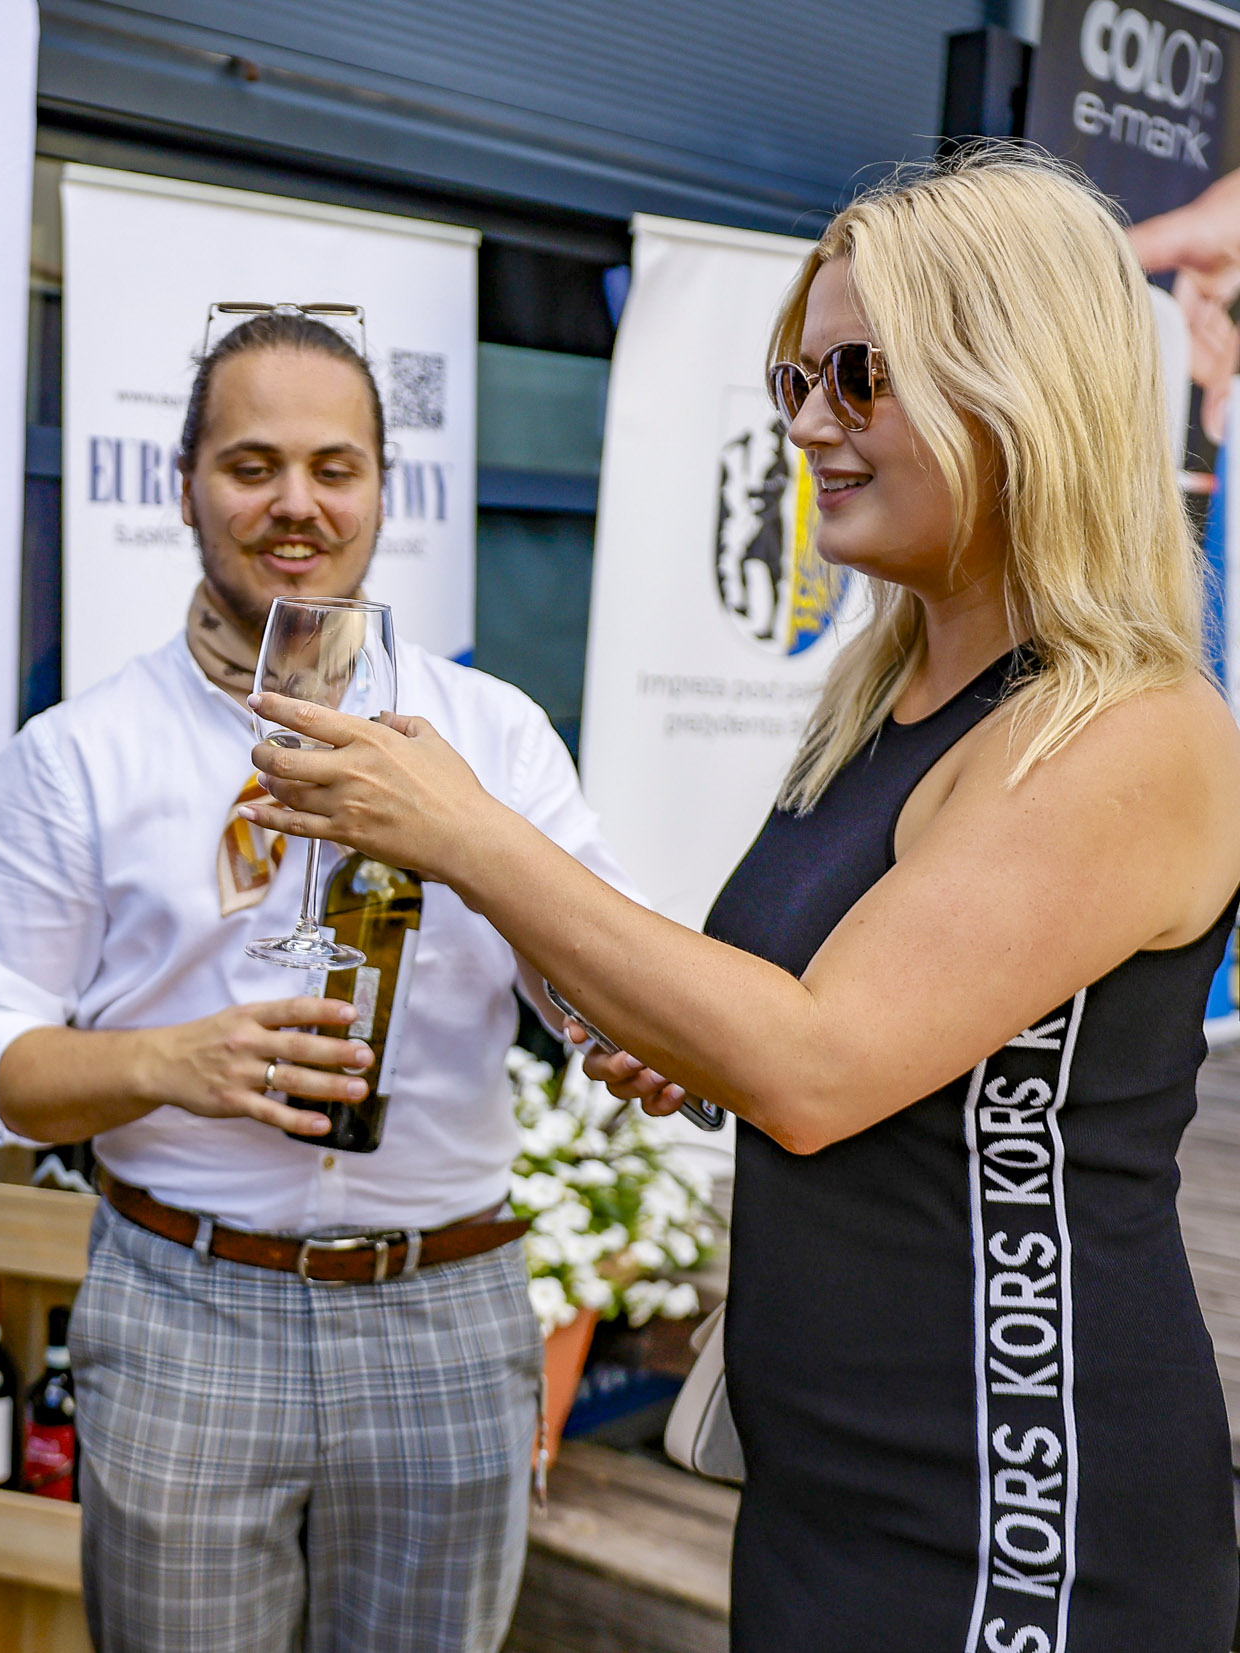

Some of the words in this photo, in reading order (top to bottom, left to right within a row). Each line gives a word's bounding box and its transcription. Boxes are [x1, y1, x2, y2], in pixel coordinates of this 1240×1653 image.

[1073, 91, 1211, 172] e-mark
[979, 1075, 1054, 1205] KORS
[988, 1230, 1058, 1397] KORS
[992, 1423, 1062, 1599] KORS
